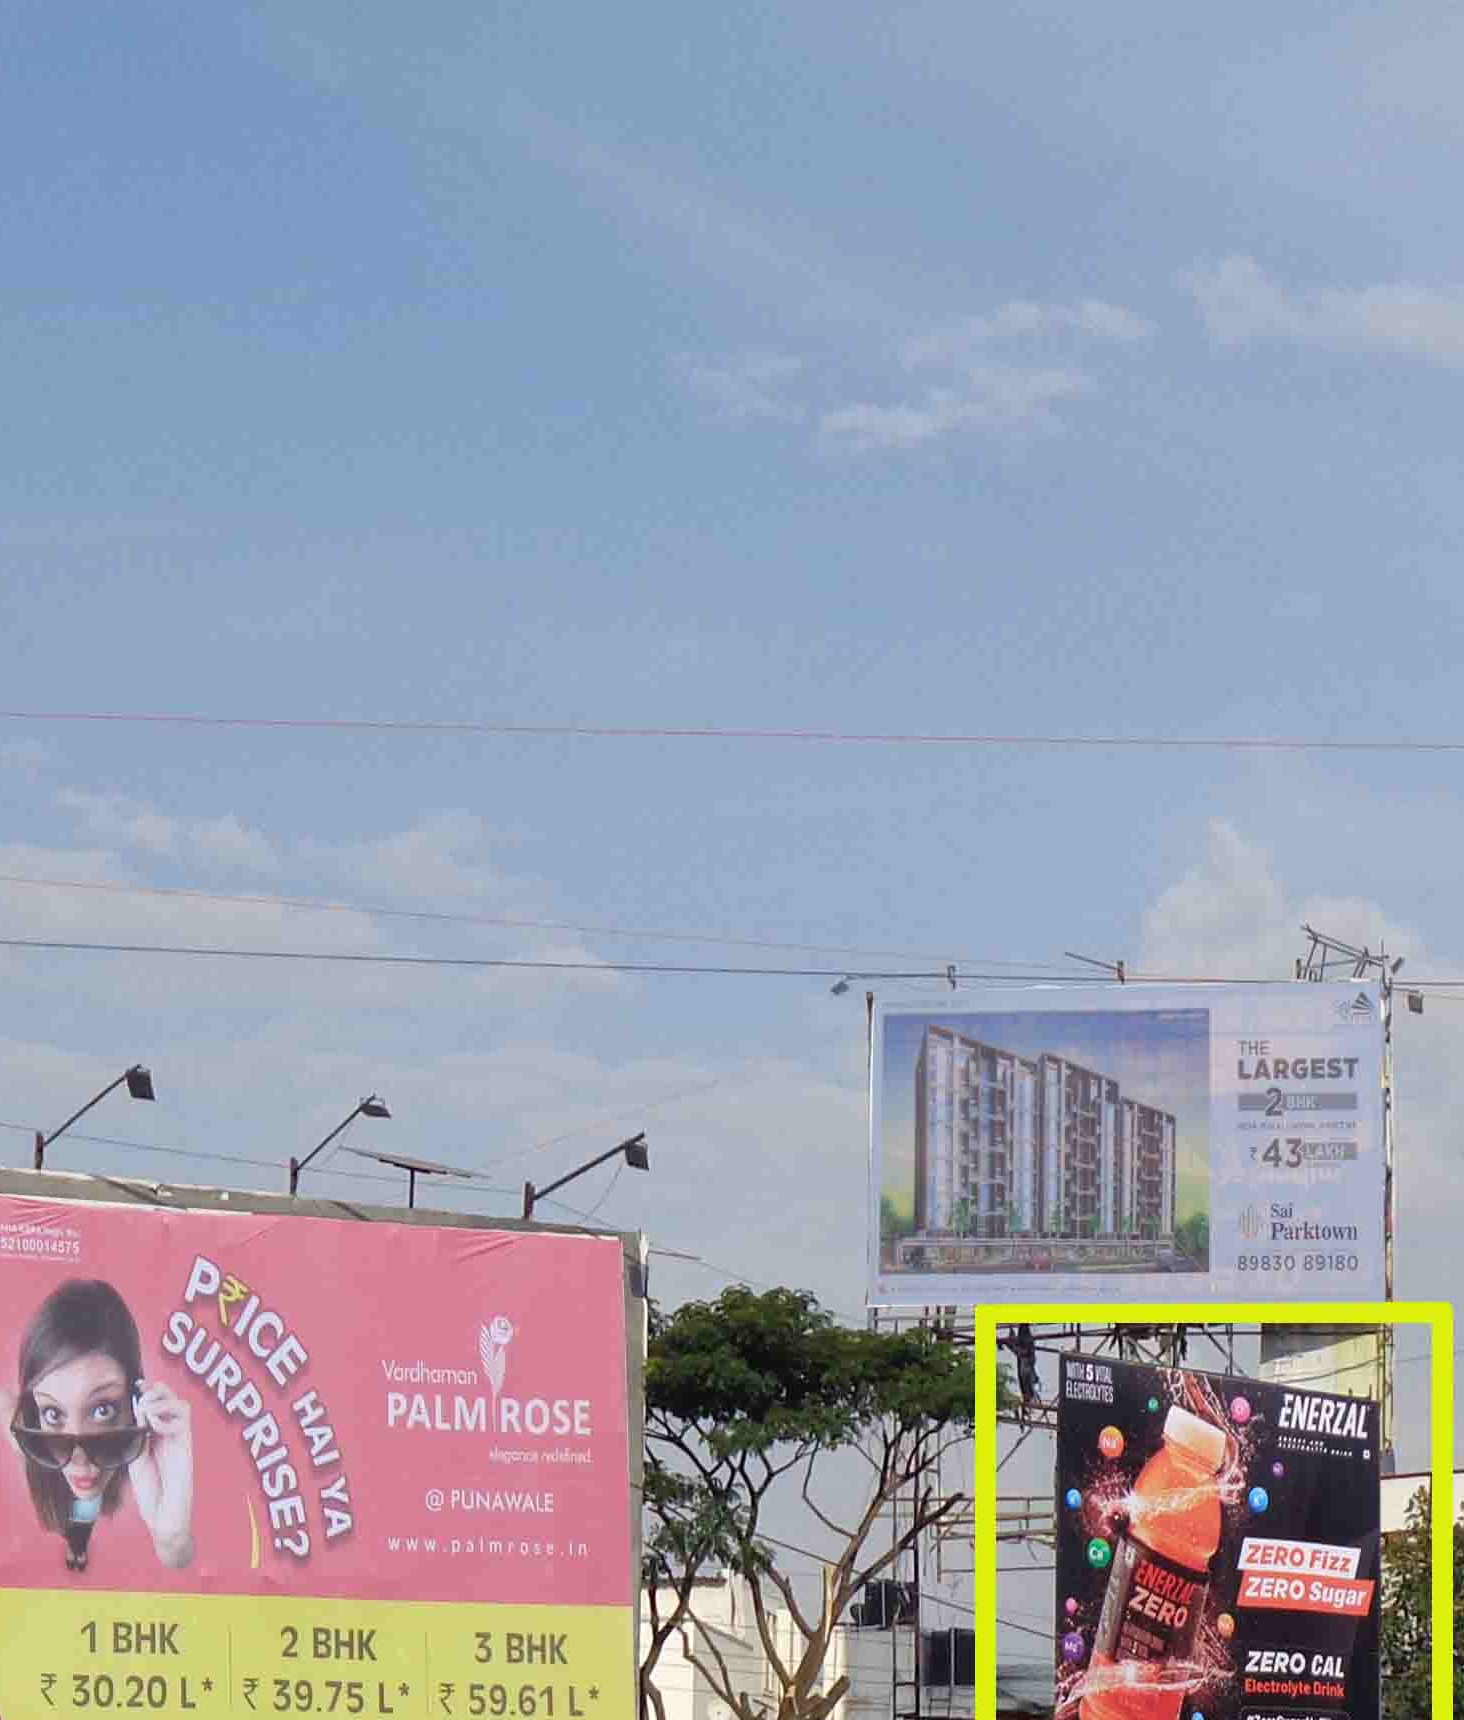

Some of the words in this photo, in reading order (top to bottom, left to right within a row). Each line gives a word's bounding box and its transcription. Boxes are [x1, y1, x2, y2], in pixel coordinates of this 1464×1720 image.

[1238, 1040, 1270, 1056] THE
[1237, 1057, 1359, 1080] LARGEST
[1264, 1087, 1283, 1117] 2
[1262, 1137, 1303, 1169] 43
[1270, 1203, 1293, 1221] Sai
[1270, 1221, 1359, 1242] Parktown
[1237, 1255, 1296, 1272] 89830
[1301, 1255, 1359, 1272] 89180
[381, 1359, 479, 1387] Vardhaman
[1086, 1365, 1094, 1380] 5
[1095, 1366, 1113, 1384] VITAL
[1065, 1380, 1114, 1402] ELECTROLYTES
[386, 1391, 488, 1434] PALM
[498, 1399, 593, 1437] ROSE
[1278, 1393, 1369, 1439] ENERZAL
[161, 1311, 310, 1558] SURPRISE?
[292, 1391, 340, 1466] HAI
[321, 1476, 353, 1538] YA
[450, 1489, 555, 1514] PUNAWALE
[1245, 1544, 1306, 1567] ZERO
[1309, 1550, 1353, 1573] Fizz
[1129, 1585, 1189, 1629] ZERO
[1245, 1577, 1306, 1600] ZERO
[1309, 1581, 1367, 1608] Sugar
[82, 1622, 98, 1653] 1
[112, 1623, 180, 1655] BHK
[280, 1627, 299, 1659] 2
[311, 1628, 378, 1661] BHK
[473, 1633, 492, 1663] 3
[504, 1633, 569, 1665] BHK
[1245, 1651, 1306, 1674] ZERO
[1311, 1654, 1345, 1678] CAL
[71, 1674, 168, 1710] 30.20
[272, 1680, 366, 1714] 39.75
[468, 1684, 557, 1717] 59.61
[1245, 1679, 1311, 1697] Electrolyte
[1313, 1681, 1345, 1698] Drink
